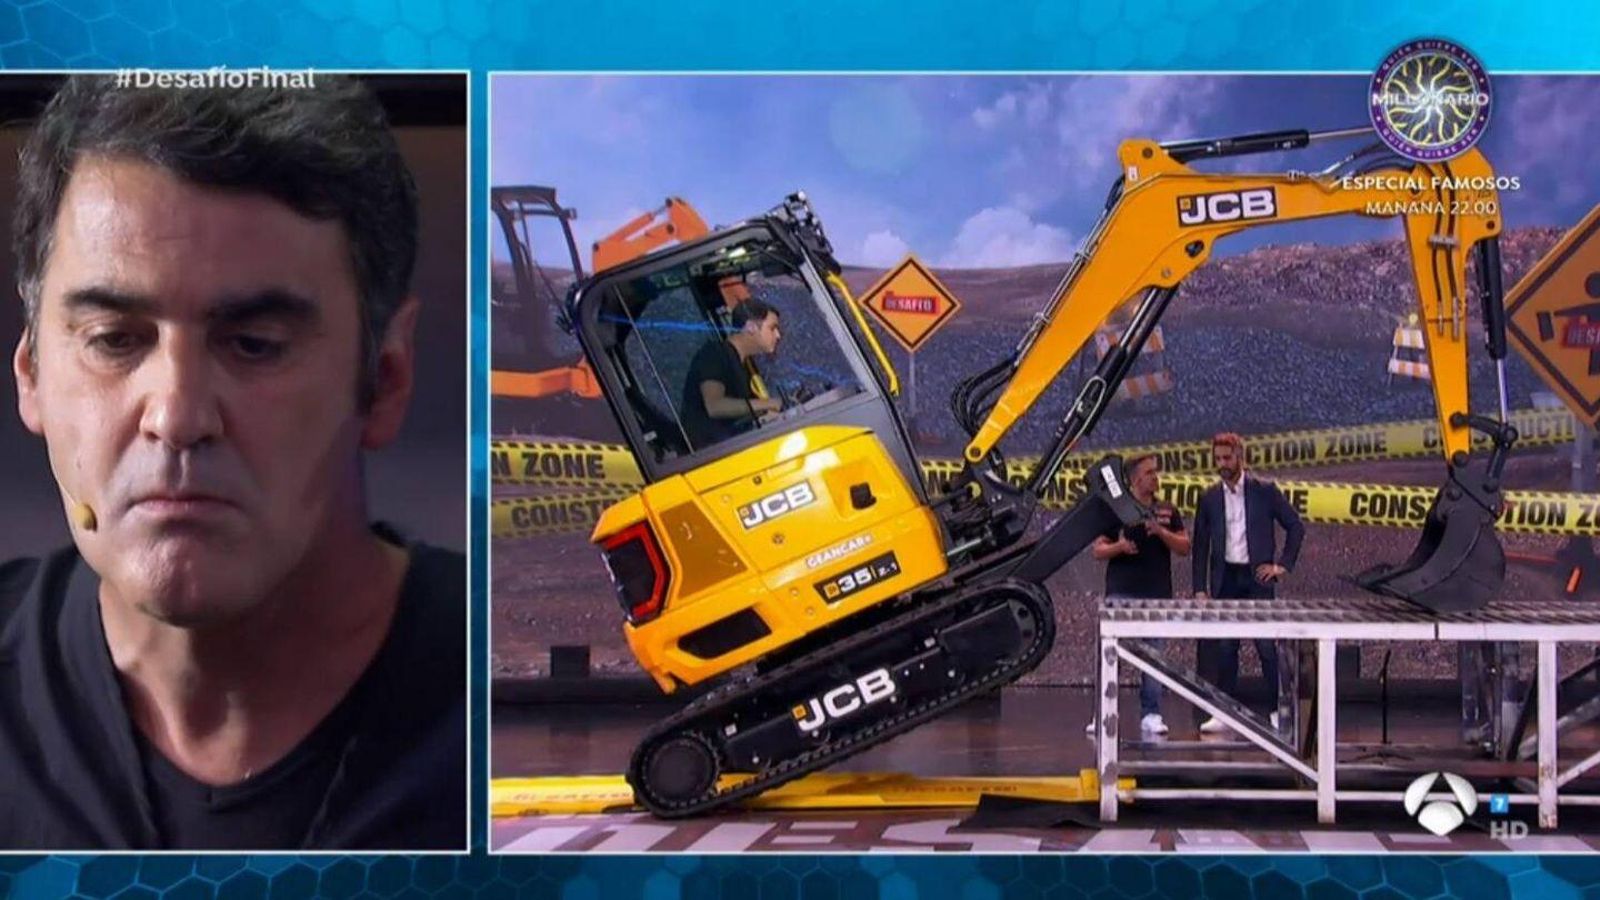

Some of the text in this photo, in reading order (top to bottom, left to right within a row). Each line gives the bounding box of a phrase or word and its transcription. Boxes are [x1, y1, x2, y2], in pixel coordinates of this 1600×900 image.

[1180, 189, 1275, 225] JCB
[1325, 431, 1387, 457] ZONE
[522, 452, 605, 478] ZONE
[743, 481, 814, 527] JCB
[838, 567, 872, 592] 35
[798, 668, 896, 731] JCB
